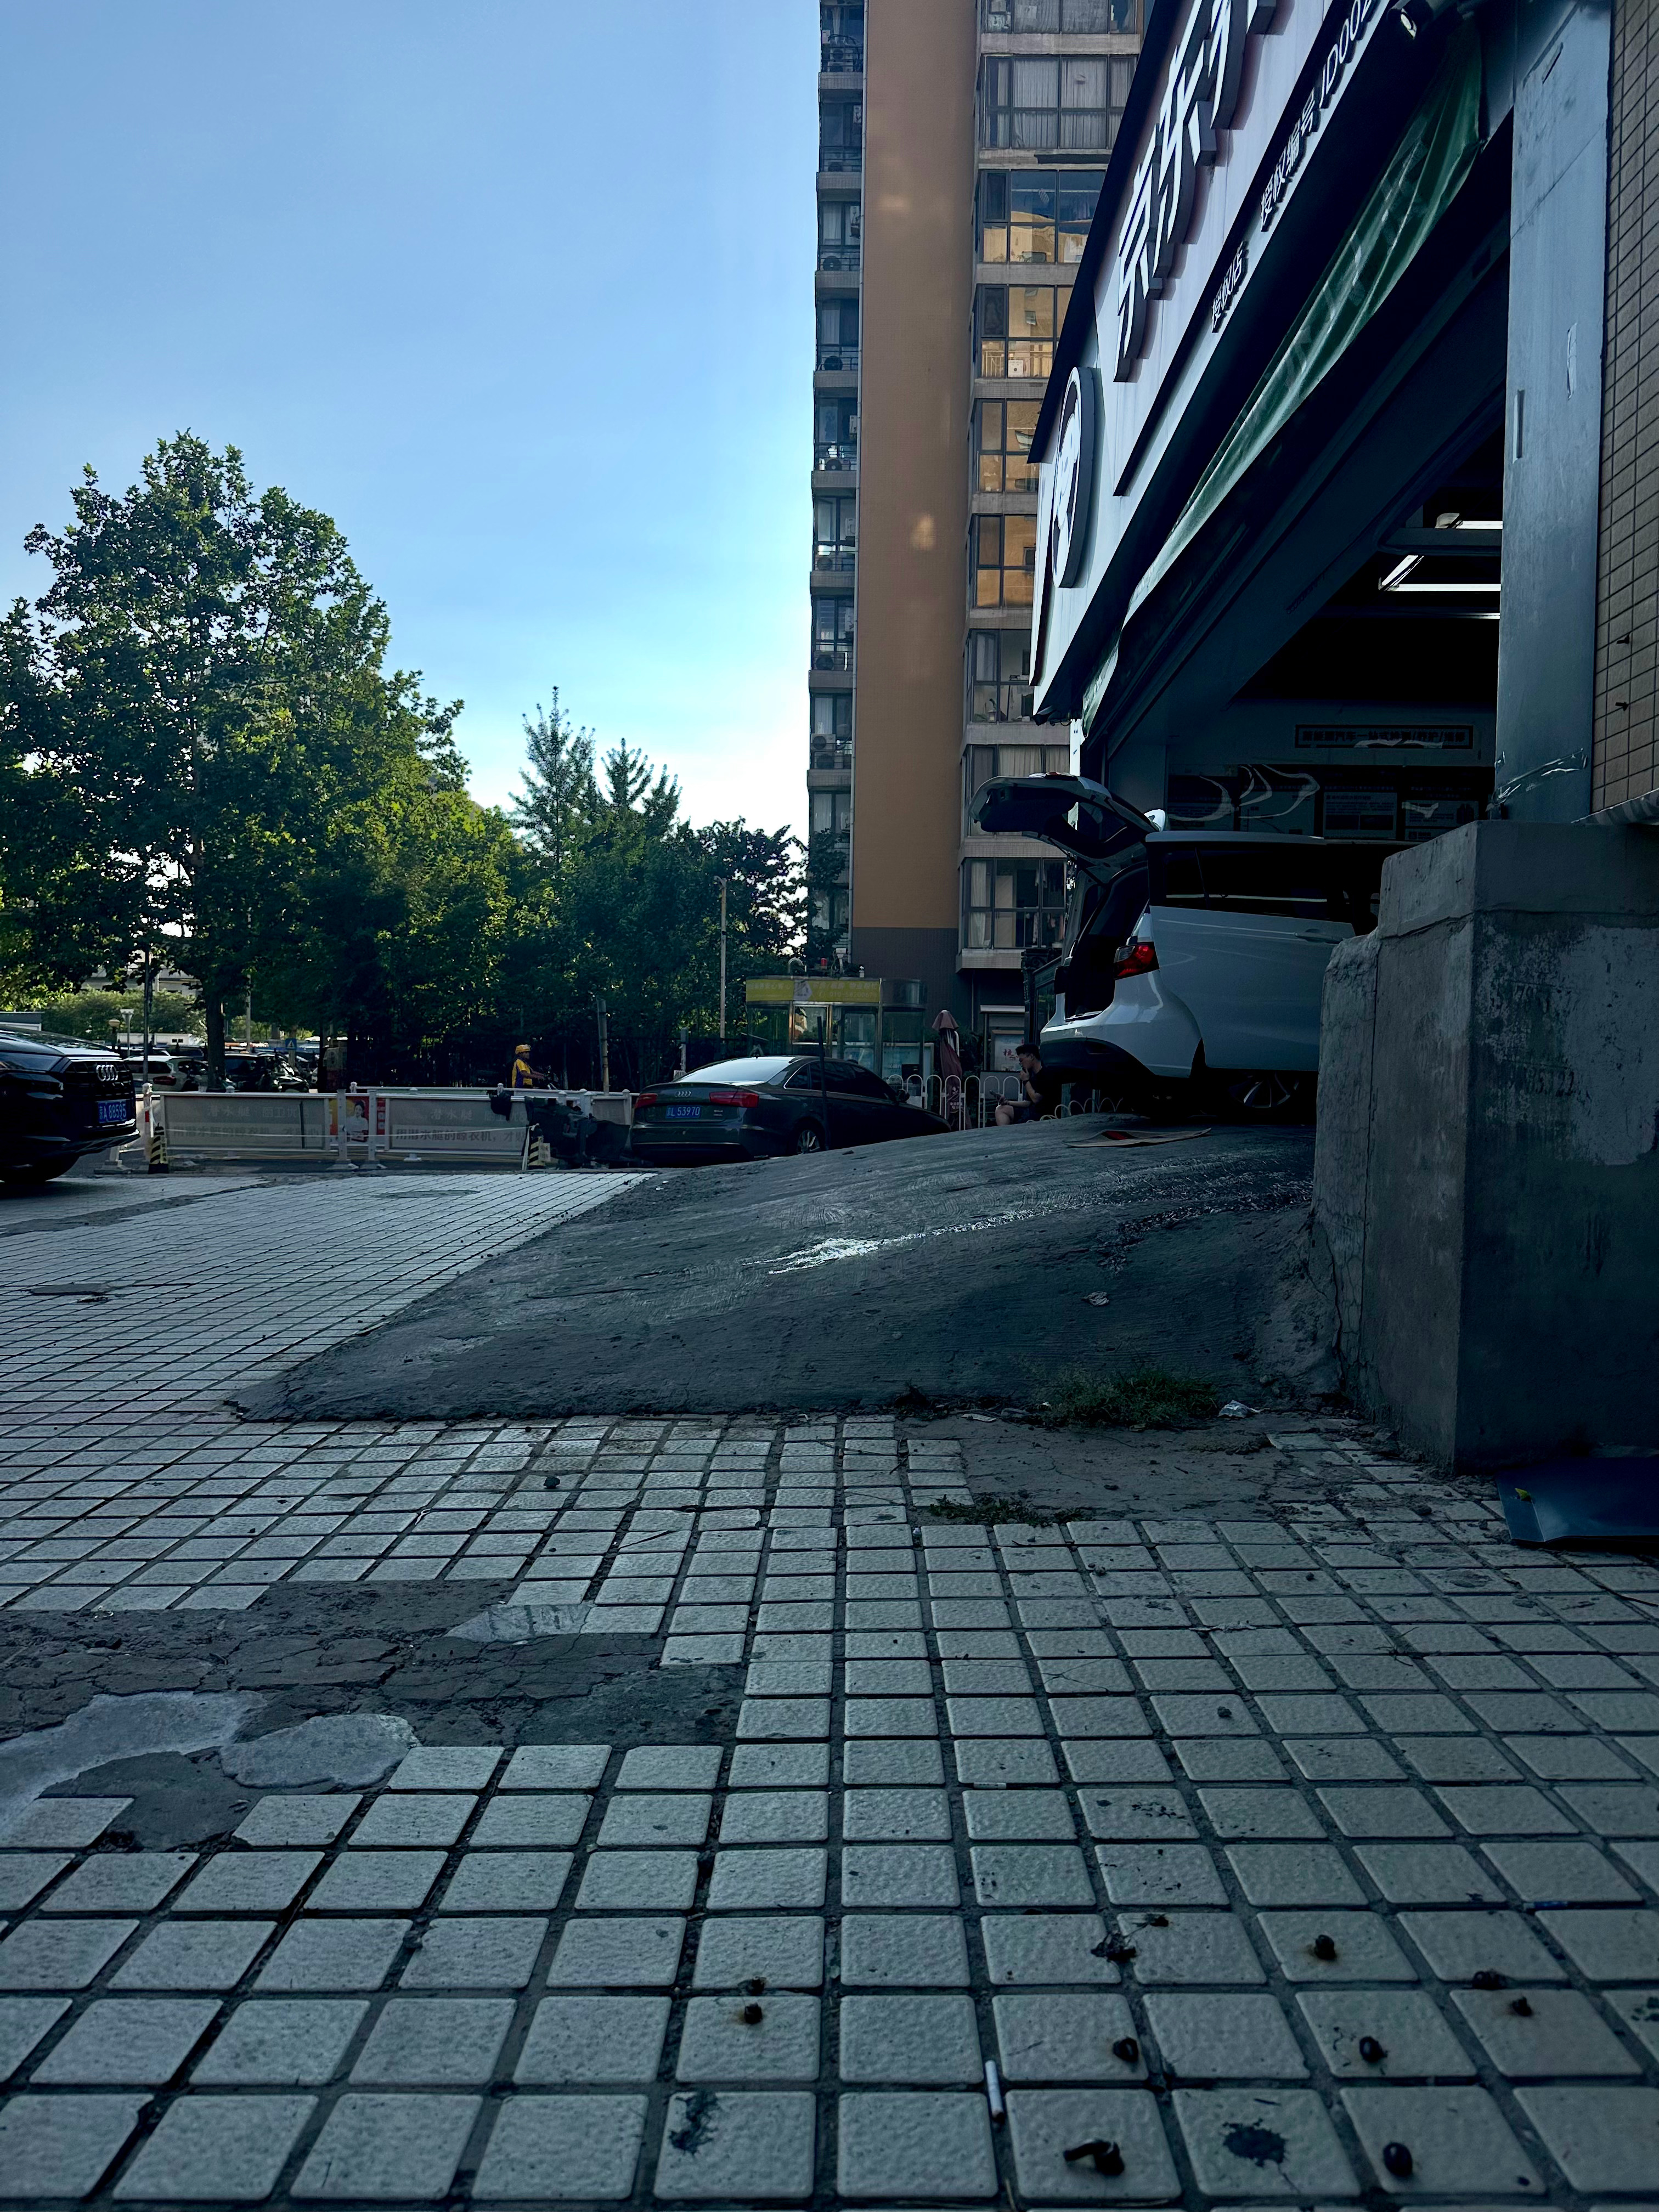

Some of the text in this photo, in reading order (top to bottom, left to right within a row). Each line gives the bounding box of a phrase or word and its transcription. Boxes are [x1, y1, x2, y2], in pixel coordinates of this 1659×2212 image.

[1114, 0, 1259, 383] 京东
[1211, 241, 1245, 331] 授权店
[431, 1108, 473, 1120] 潜水艇
